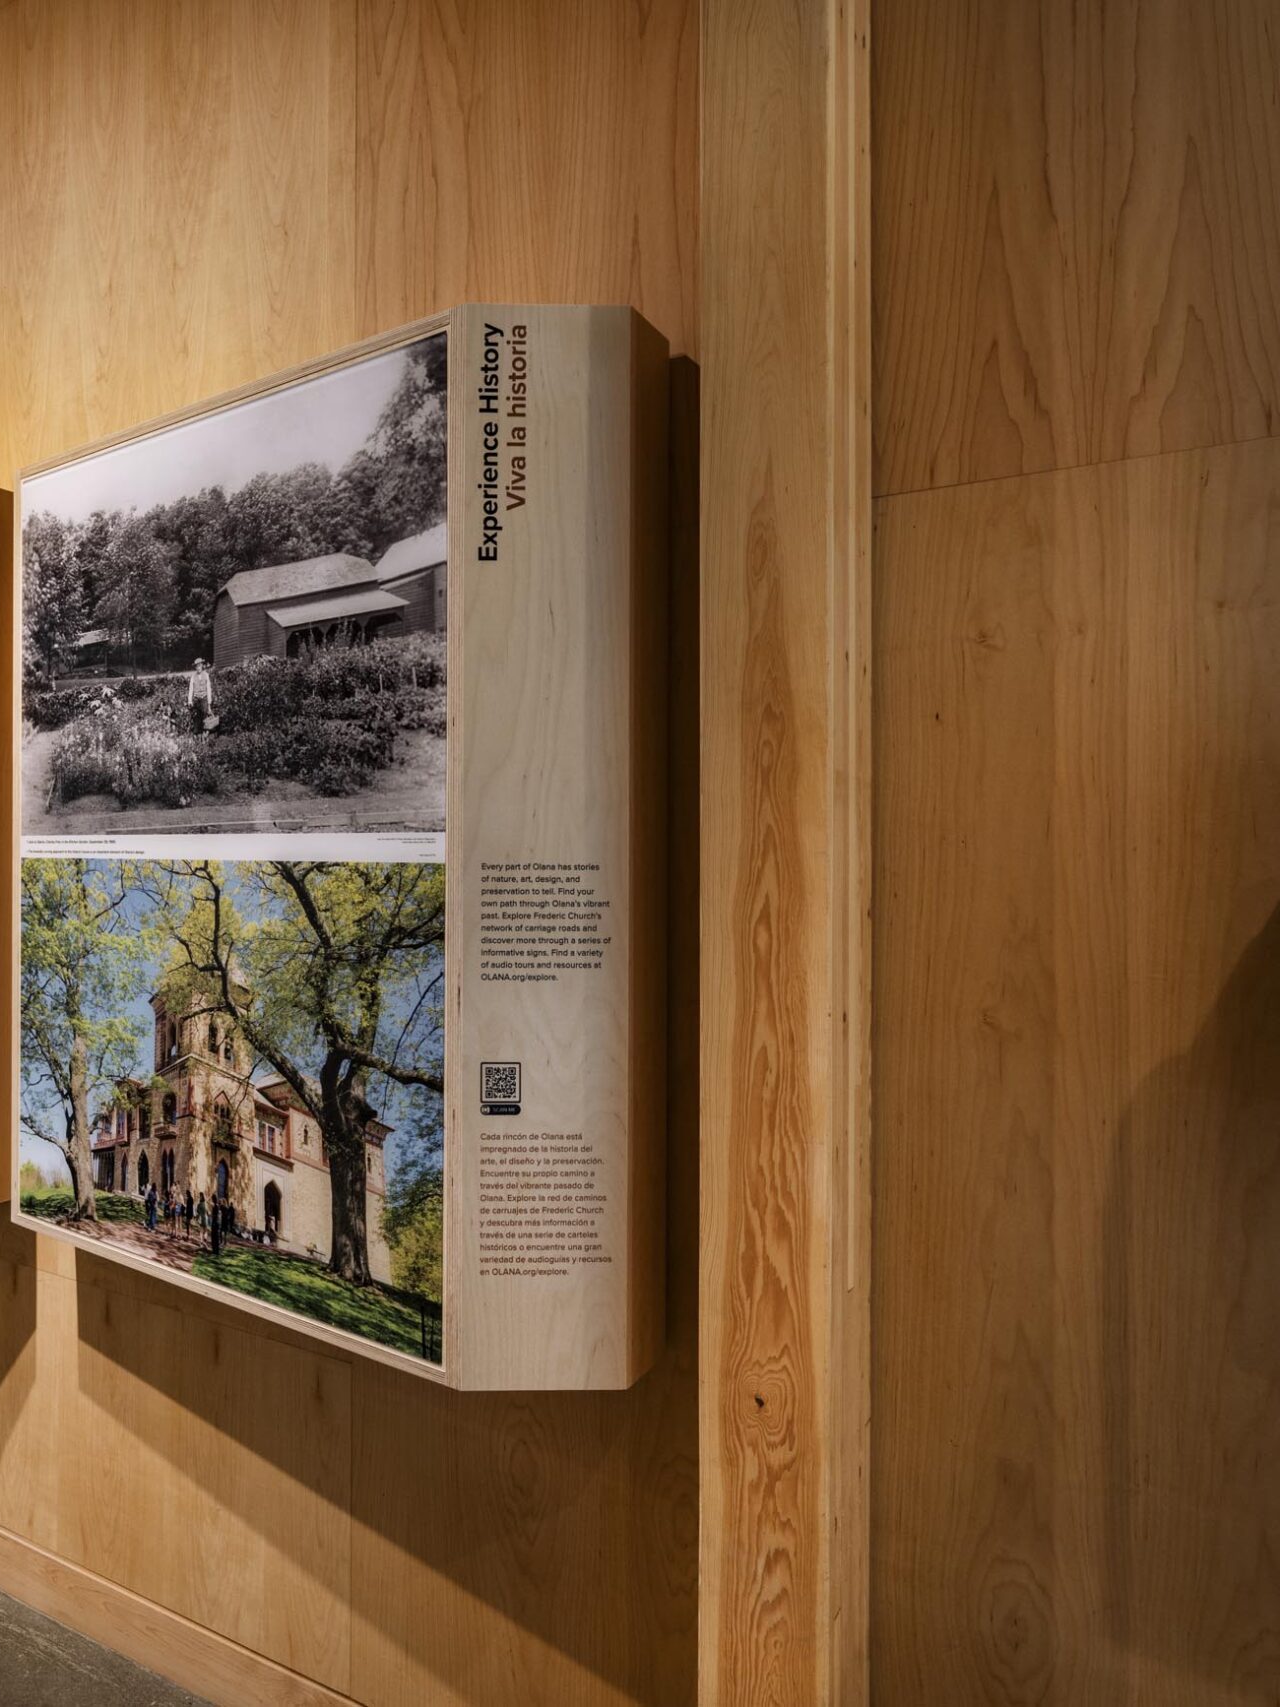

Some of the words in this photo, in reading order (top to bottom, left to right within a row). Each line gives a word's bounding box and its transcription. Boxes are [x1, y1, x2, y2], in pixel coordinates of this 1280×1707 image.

[478, 323, 503, 413] History
[506, 325, 527, 417] historia
[506, 426, 526, 447] la
[506, 456, 526, 511] Viva
[478, 422, 503, 561] Experience
[481, 863, 504, 872] Every
[505, 863, 521, 872] part
[522, 863, 531, 871] of
[532, 863, 556, 871] Olana
[557, 863, 572, 871] has
[574, 863, 600, 871] stories
[481, 875, 489, 883] of
[491, 875, 518, 884] nature,
[520, 875, 533, 884] art,
[535, 875, 563, 884] design,
[565, 875, 580, 883] and
[481, 887, 530, 897] preservation
[531, 887, 540, 895] to
[541, 887, 556, 895] tell.
[558, 887, 575, 895] Find
[577, 889, 595, 897] your
[500, 900, 517, 909] path
[519, 900, 550, 909] through
[481, 912, 499, 921] past.
[502, 912, 531, 921] Explore
[533, 912, 566, 920] Frederic
[568, 912, 602, 920] Church's
[481, 924, 513, 932] network
[515, 924, 523, 932] of
[524, 924, 557, 933] carriage
[558, 924, 580, 932] roads
[582, 924, 597, 932] and
[481, 936, 515, 944] discover
[538, 936, 569, 946] through
[578, 936, 601, 944] series
[603, 936, 611, 944] of
[526, 949, 549, 958] signs.
[576, 949, 603, 958] variety
[481, 961, 489, 969] of
[490, 961, 513, 969] audio
[514, 961, 535, 969] tours
[536, 961, 552, 969] and
[594, 961, 601, 969] at
[481, 973, 558, 982] OLANA.org/explore.
[480, 1145, 527, 1154] impregnado
[528, 1145, 539, 1153] de
[541, 1145, 548, 1153] la
[550, 1145, 578, 1153] historia
[580, 1145, 592, 1153] del
[499, 1157, 507, 1165] el
[536, 1159, 542, 1167] y
[543, 1157, 551, 1165] la
[507, 1194, 536, 1203] Explore
[538, 1194, 546, 1202] la
[547, 1194, 561, 1202] red
[562, 1194, 573, 1202] de
[574, 1194, 607, 1202] caminos
[480, 1206, 490, 1214] de
[492, 1208, 528, 1216] carruajes
[529, 1206, 540, 1214] de
[542, 1206, 574, 1214] Frederic
[576, 1206, 604, 1214] Church
[479, 1220, 485, 1228] y
[505, 1231, 516, 1239] de
[534, 1231, 553, 1239] serie
[555, 1231, 566, 1239] de
[567, 1231, 598, 1239] carteles
